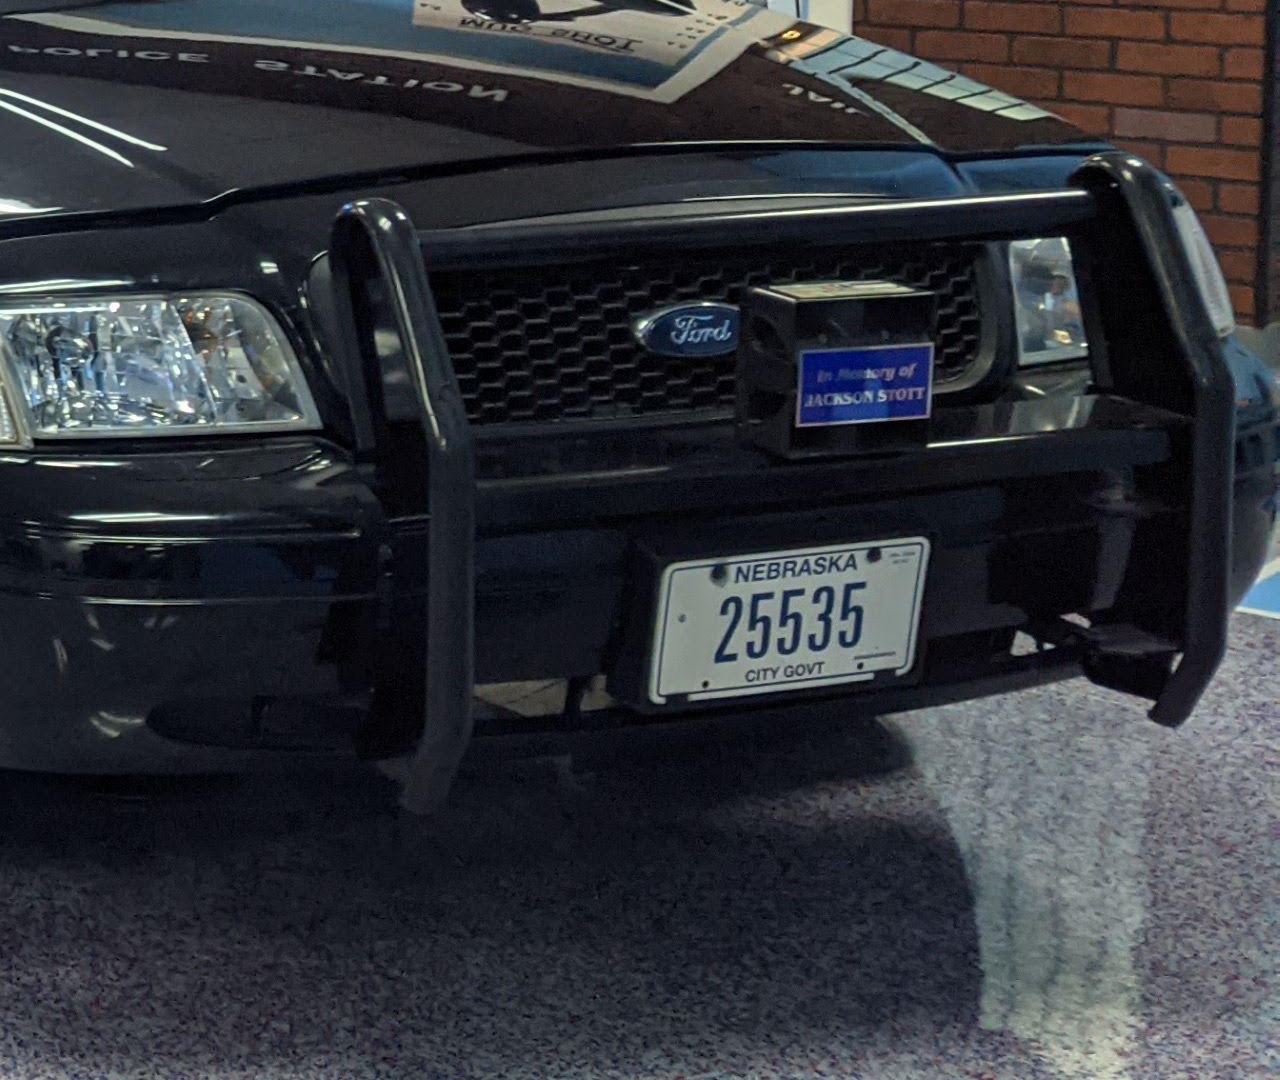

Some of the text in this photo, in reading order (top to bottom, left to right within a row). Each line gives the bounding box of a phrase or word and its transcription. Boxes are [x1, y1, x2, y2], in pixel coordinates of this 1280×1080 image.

[669, 314, 733, 345] Ford
[898, 362, 918, 379] of
[803, 386, 926, 408] JACKSON STOTT
[734, 553, 858, 584] NEBRASKA
[714, 581, 868, 664] 25535
[745, 661, 826, 683] CITY GOVT
